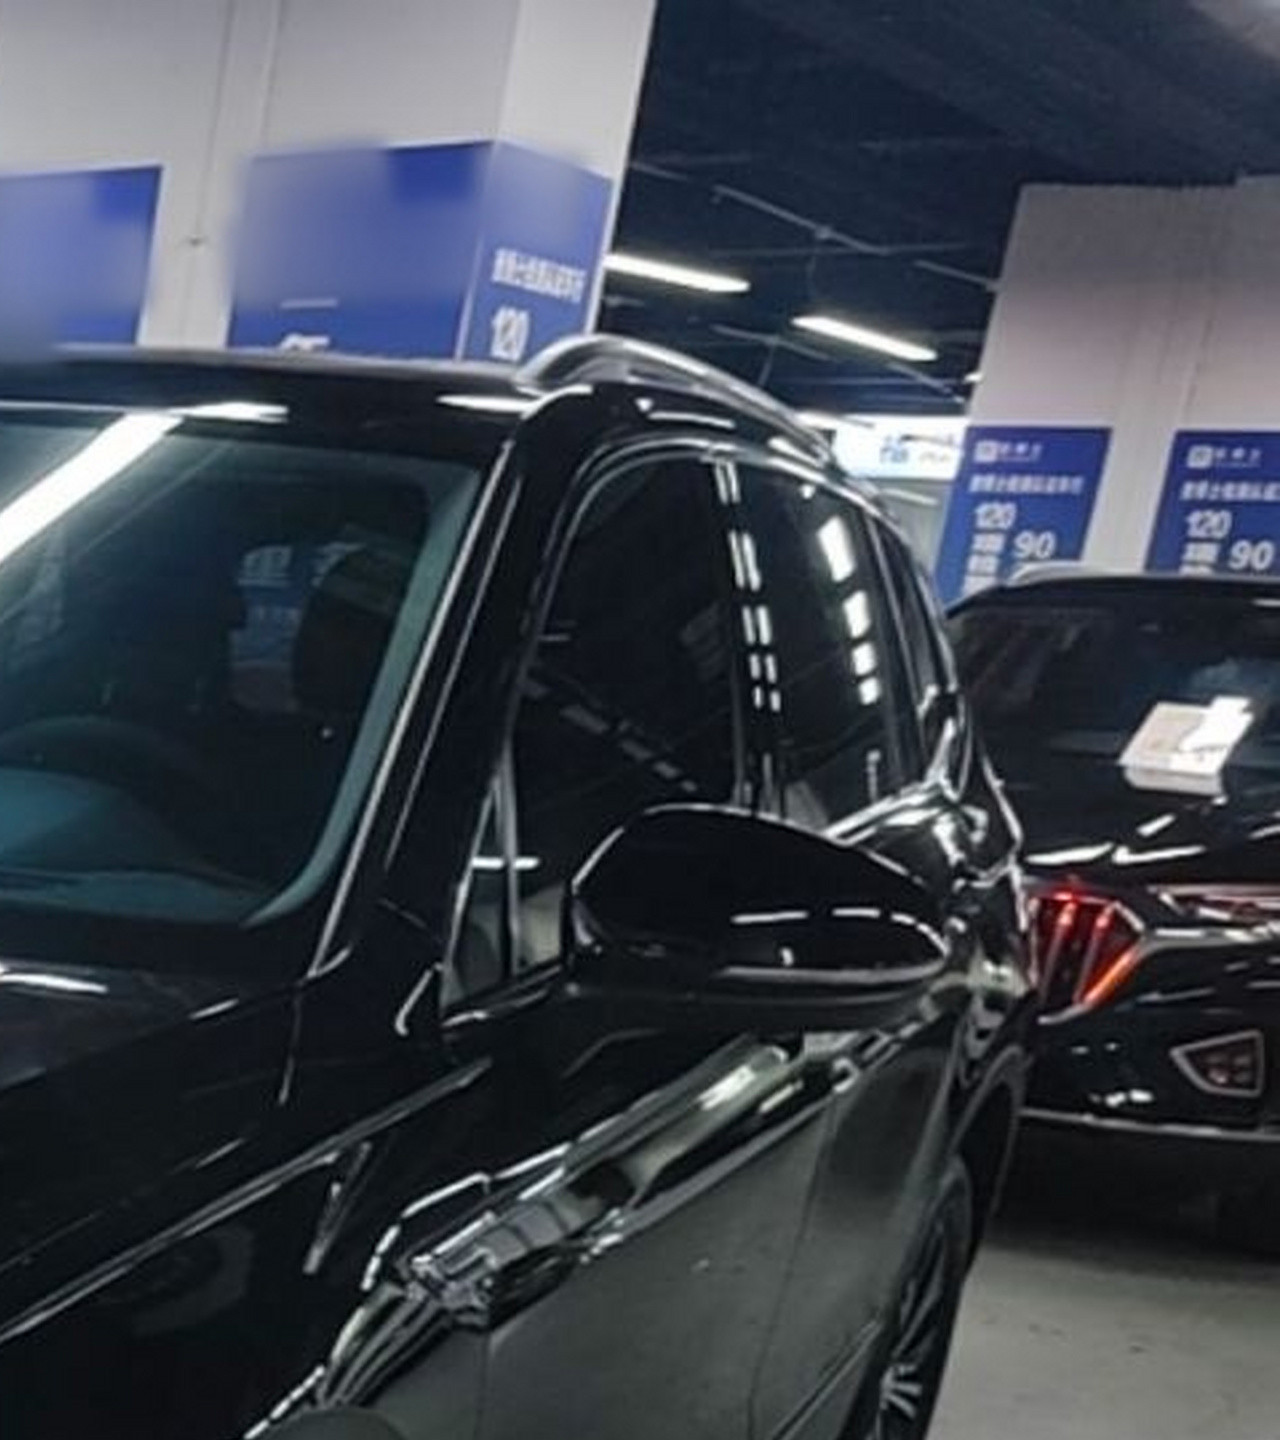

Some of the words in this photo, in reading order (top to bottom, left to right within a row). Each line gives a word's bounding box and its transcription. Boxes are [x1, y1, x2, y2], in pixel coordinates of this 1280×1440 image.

[1186, 510, 1232, 539] 120
[1013, 530, 1057, 559] 90
[1228, 539, 1274, 571] 90
